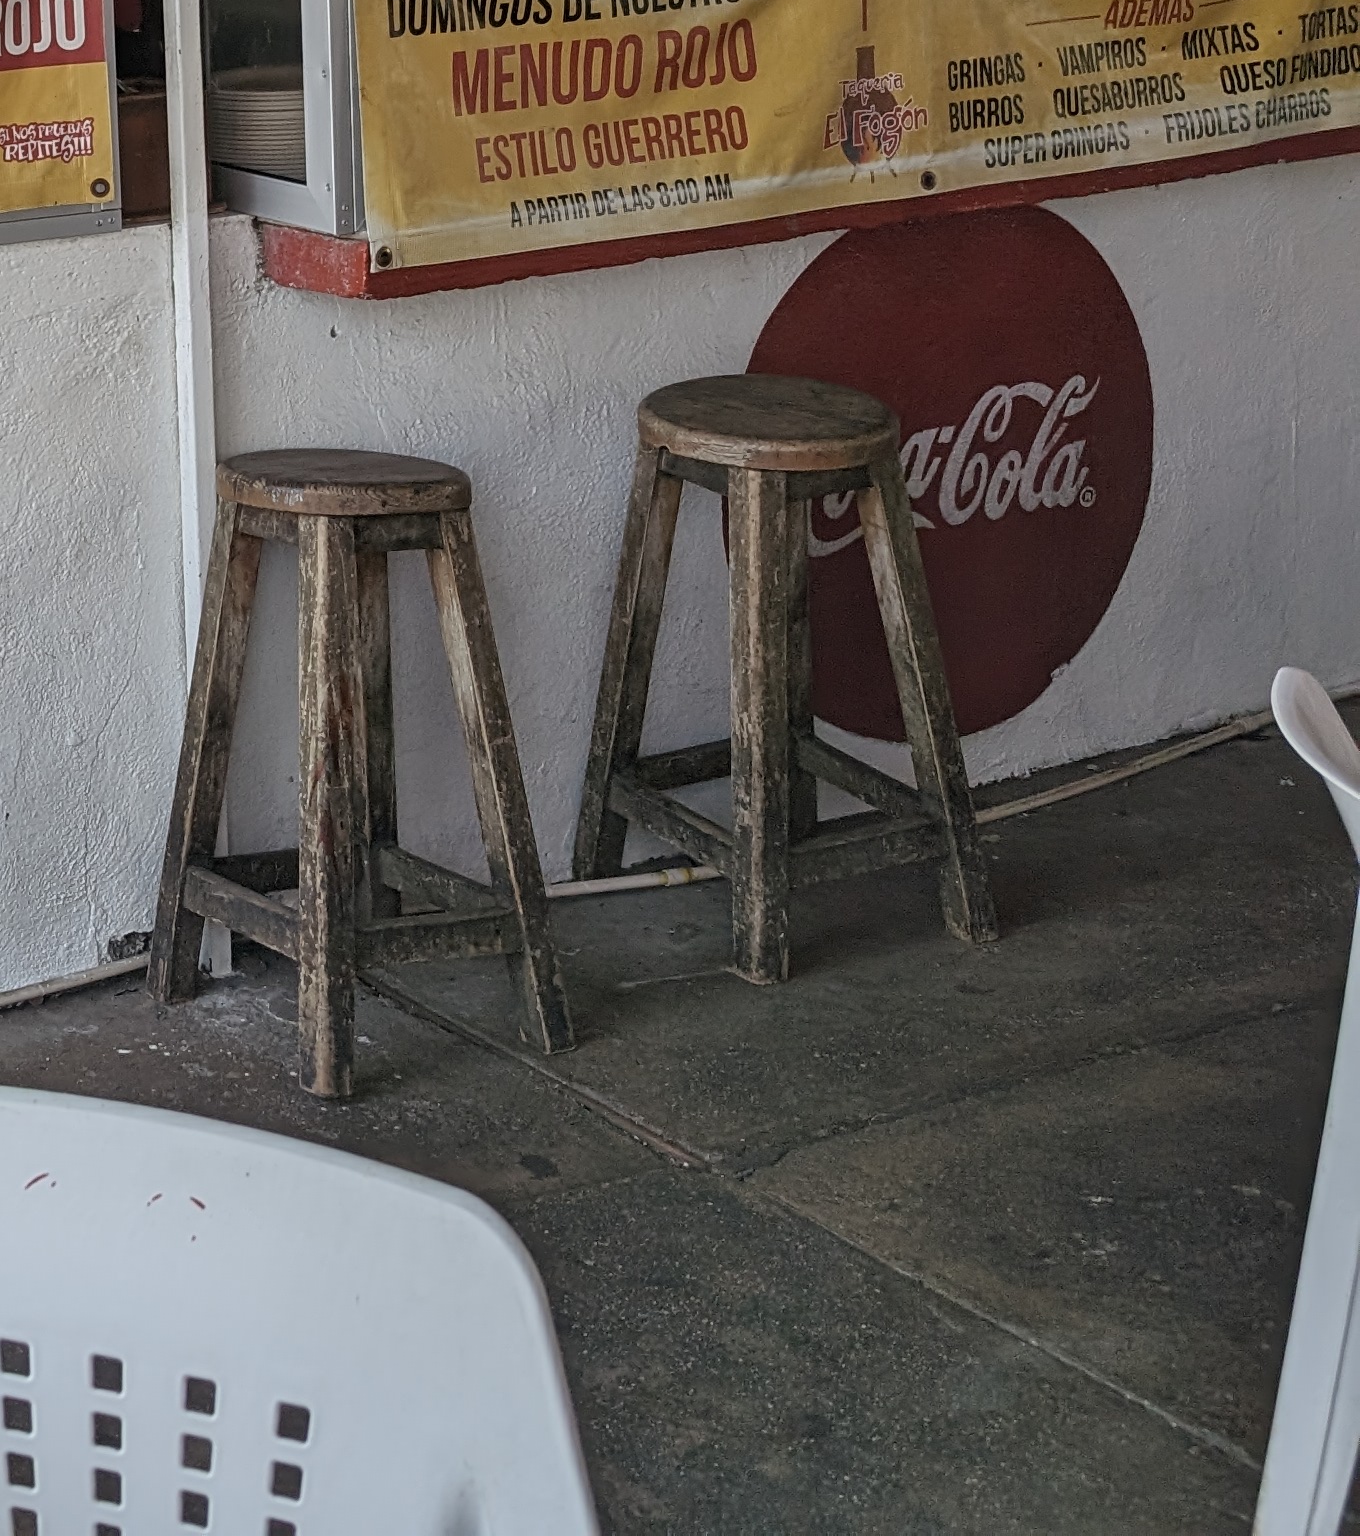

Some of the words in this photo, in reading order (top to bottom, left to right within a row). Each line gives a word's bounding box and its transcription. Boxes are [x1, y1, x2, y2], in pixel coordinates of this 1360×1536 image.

[452, 34, 643, 117] MENUDO
[653, 18, 758, 94] ROJO
[947, 53, 1026, 91] GRINGAS
[1056, 37, 1147, 77] VAMPIROS
[1181, 22, 1260, 61] MIXTAS
[1298, 4, 1359, 43] TORTAS
[839, 72, 905, 105] Taqueria
[949, 96, 1024, 133] BURROS
[1053, 72, 1186, 119] QUESABURROS
[1219, 56, 1287, 96] QUESO
[1290, 44, 1360, 84] FUNDIDO
[4, 135, 93, 162] REPITES!!!
[37, 119, 93, 138] PRUEBAS
[475, 127, 576, 183] ESTILO
[583, 106, 749, 168] GUERRERO
[823, 107, 847, 151] El
[853, 95, 929, 158] Fogón
[984, 134, 1046, 168] SUPER
[1051, 122, 1130, 159] GRINGAS
[1163, 105, 1251, 145] FRIJOLES
[1255, 90, 1332, 128] CHARROS
[510, 201, 523, 228] A
[525, 193, 590, 226] PARTIR
[592, 188, 615, 216] DE
[616, 184, 655, 213] LAS
[658, 178, 701, 208] 8:00
[704, 173, 734, 204] AM
